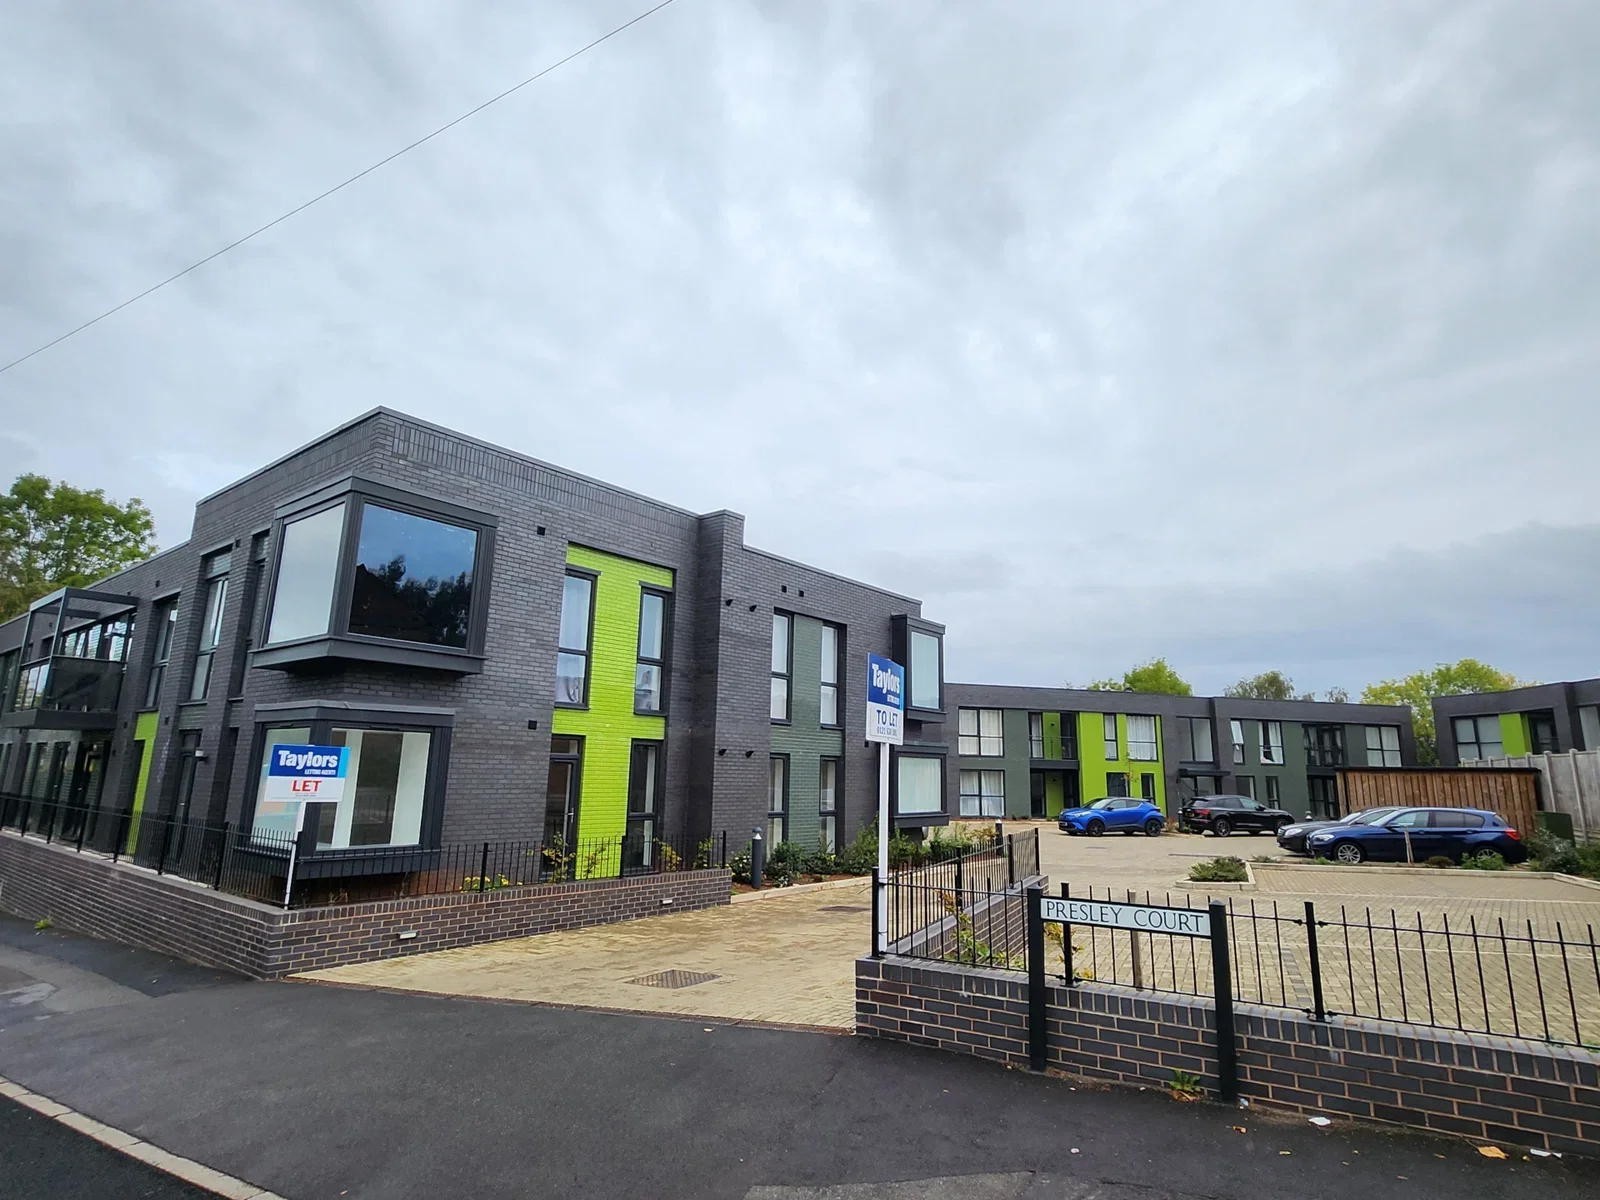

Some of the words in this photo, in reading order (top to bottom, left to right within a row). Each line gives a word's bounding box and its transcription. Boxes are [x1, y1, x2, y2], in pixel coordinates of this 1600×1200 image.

[872, 663, 900, 694] Taylors
[876, 709, 887, 725] TO
[889, 711, 898, 728] LET
[278, 750, 338, 770] Taylors
[292, 780, 322, 792] LET
[1046, 901, 1122, 924] PRESLEY
[1134, 909, 1204, 932] COURT
